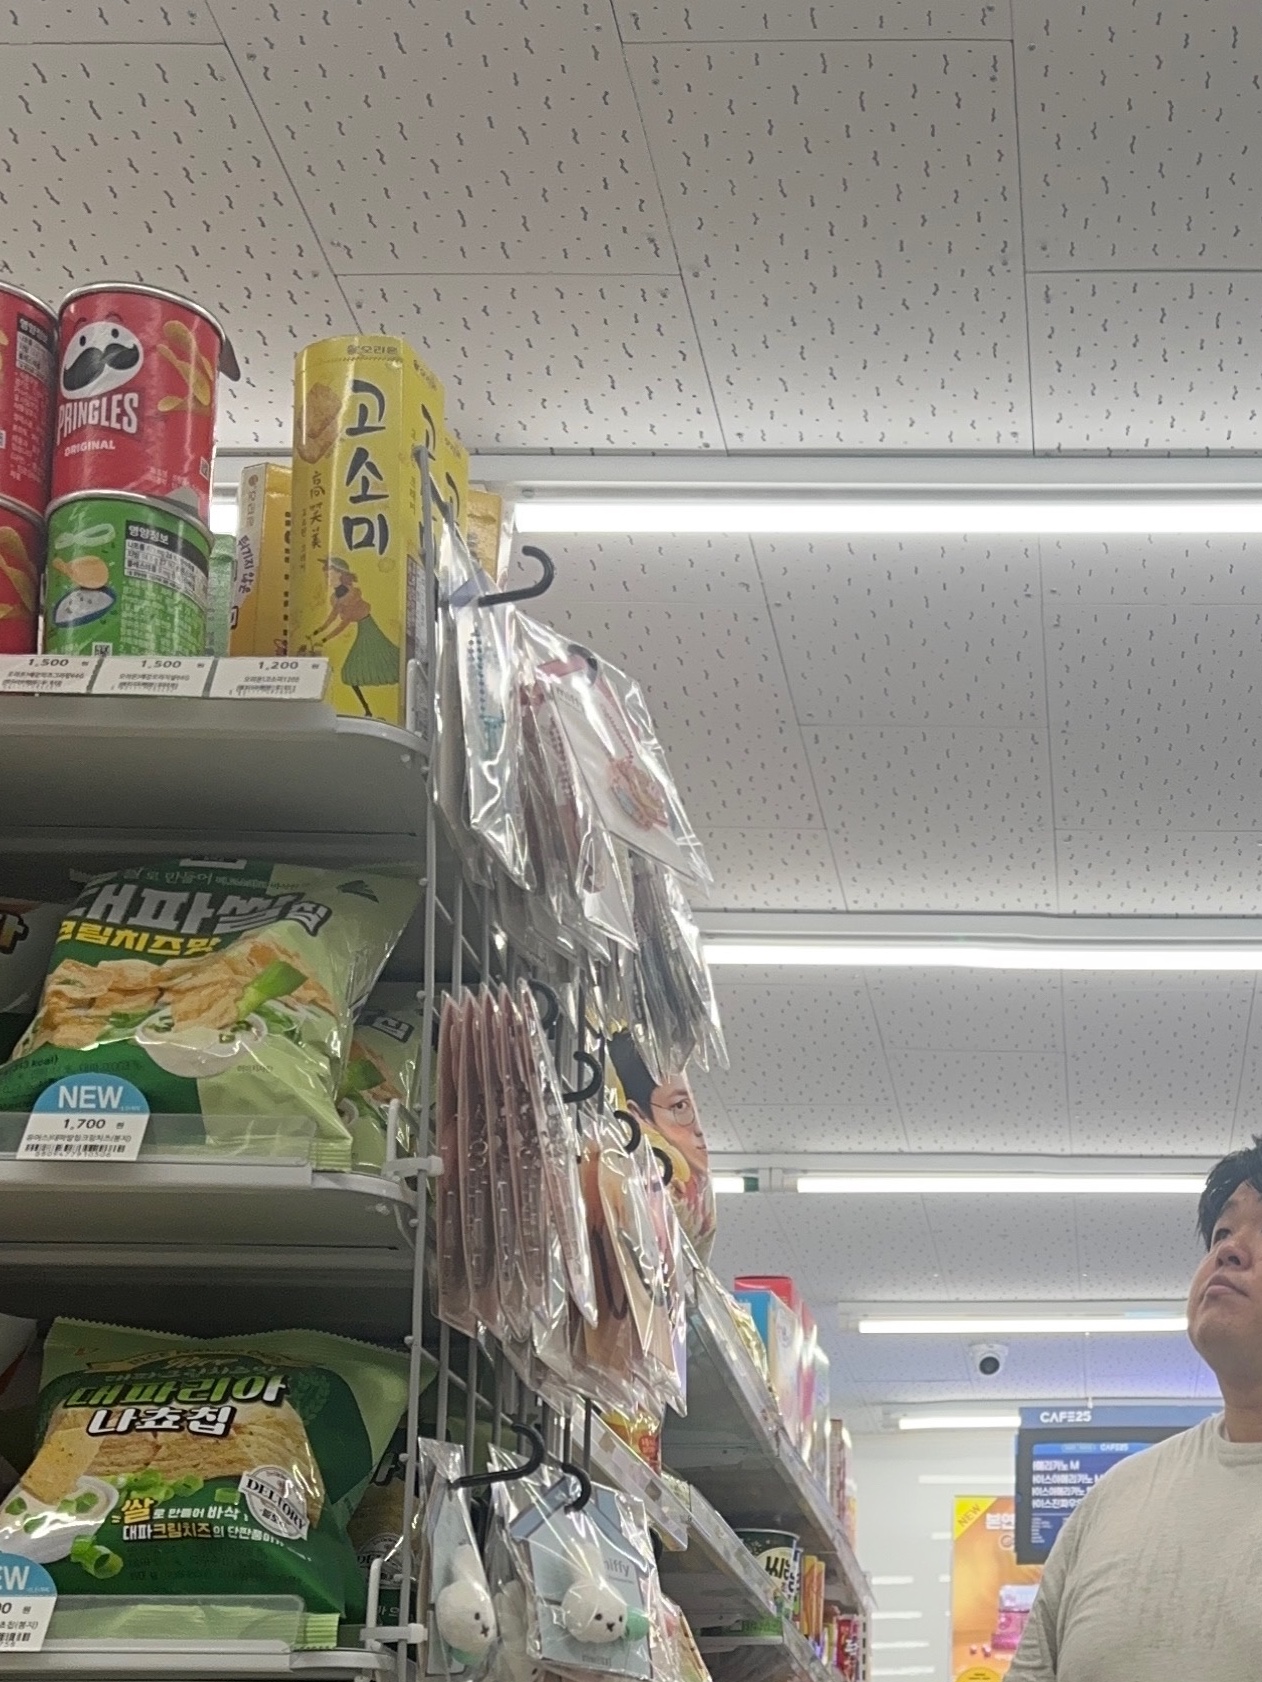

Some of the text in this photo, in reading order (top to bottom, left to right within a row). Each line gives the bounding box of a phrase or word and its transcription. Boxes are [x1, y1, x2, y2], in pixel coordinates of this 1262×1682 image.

[57, 393, 139, 445] PRINGLES
[64, 440, 116, 457] ORIGINAL
[342, 379, 390, 557] 고소미
[128, 524, 169, 545] 영양정보
[28, 658, 69, 669] 1,500
[140, 660, 182, 670] 1,500
[258, 661, 300, 671] 1,200
[58, 1085, 124, 1109] NEW
[64, 1119, 106, 1131] 1,700
[63, 1374, 288, 1407] 대파리아
[88, 1406, 234, 1436] 나쵸칩
[1040, 1411, 1092, 1423] CAFE25
[168, 1507, 205, 1520] 만들어
